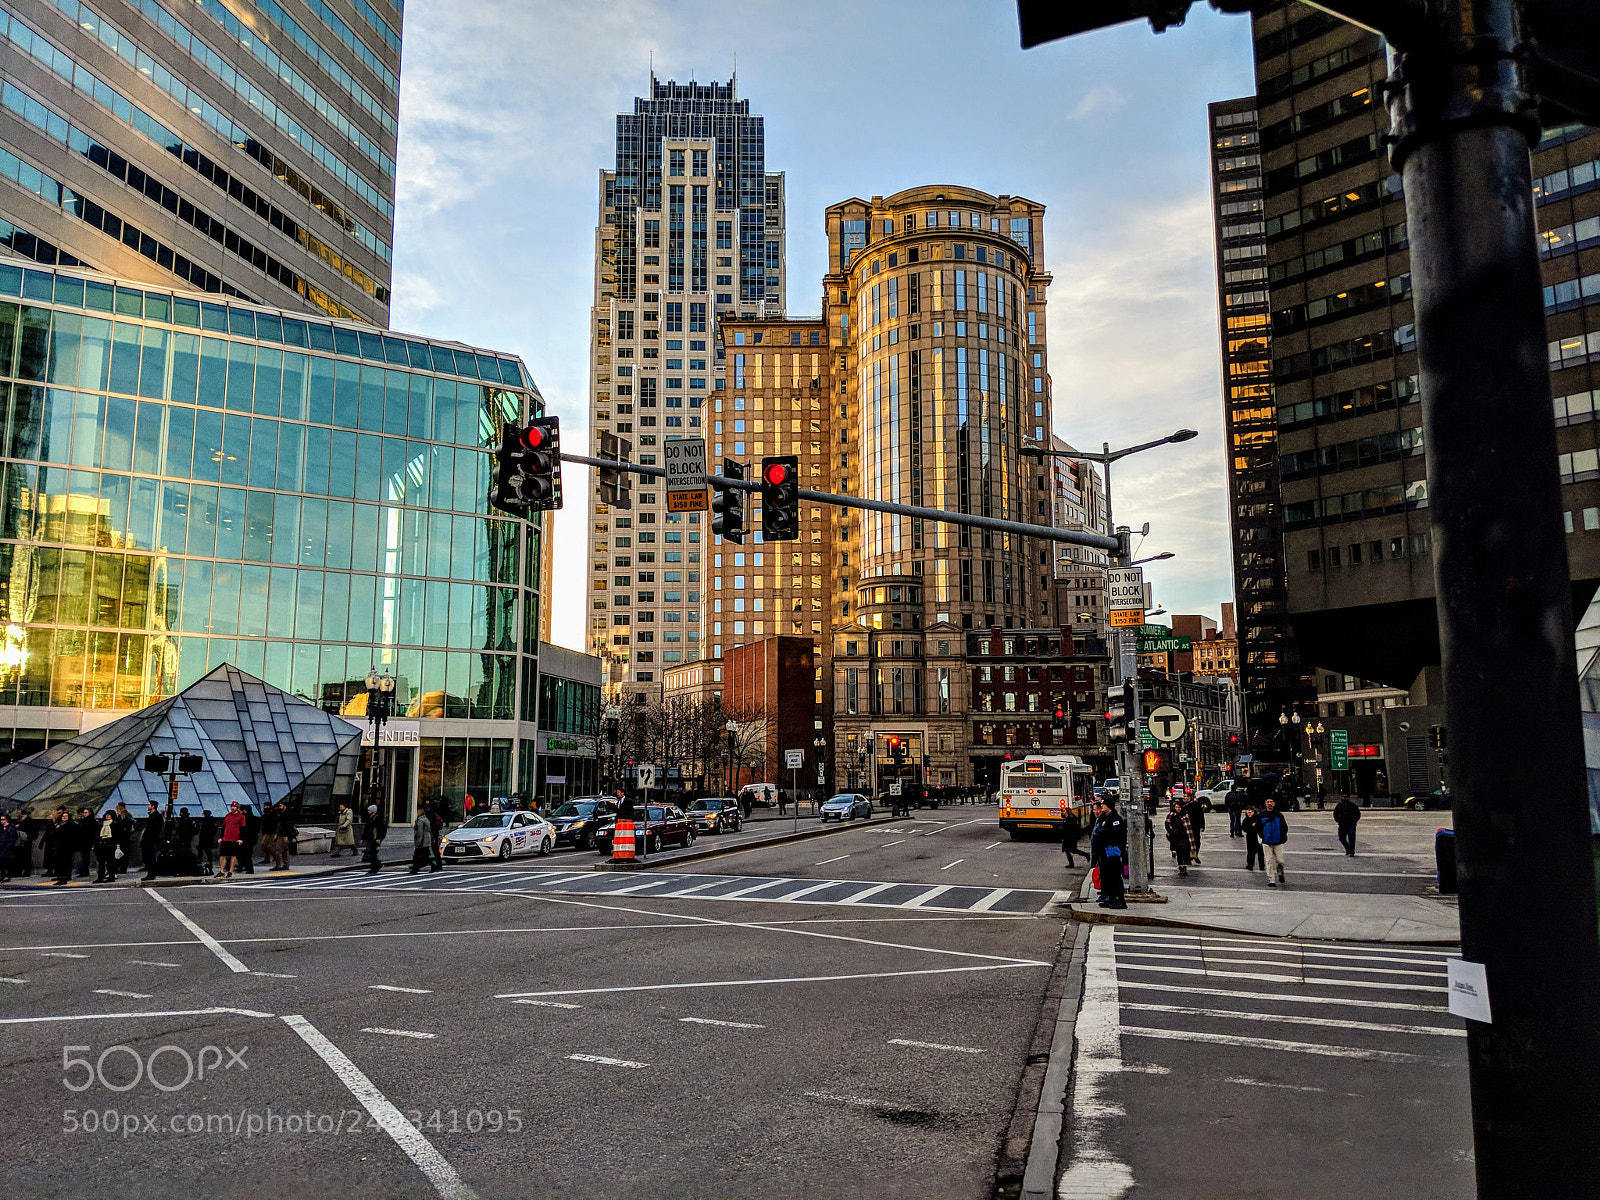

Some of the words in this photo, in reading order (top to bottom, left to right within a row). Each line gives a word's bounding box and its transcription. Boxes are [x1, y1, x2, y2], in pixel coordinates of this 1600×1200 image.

[667, 446, 680, 458] DO
[684, 445, 703, 457] NOT
[670, 462, 703, 474] BLOCK
[669, 477, 706, 486] INTERSECTION
[673, 493, 688, 501] STATE
[690, 500, 703, 508] FINE
[1110, 573, 1120, 583] DO
[1125, 572, 1141, 582] NOT
[1112, 586, 1140, 596] BLOCK
[1140, 625, 1161, 635] SUMMER
[1144, 639, 1180, 651] ATLANTIC
[1154, 715, 1180, 737] T
[366, 730, 419, 742] CENTER
[889, 741, 907, 756] 15
